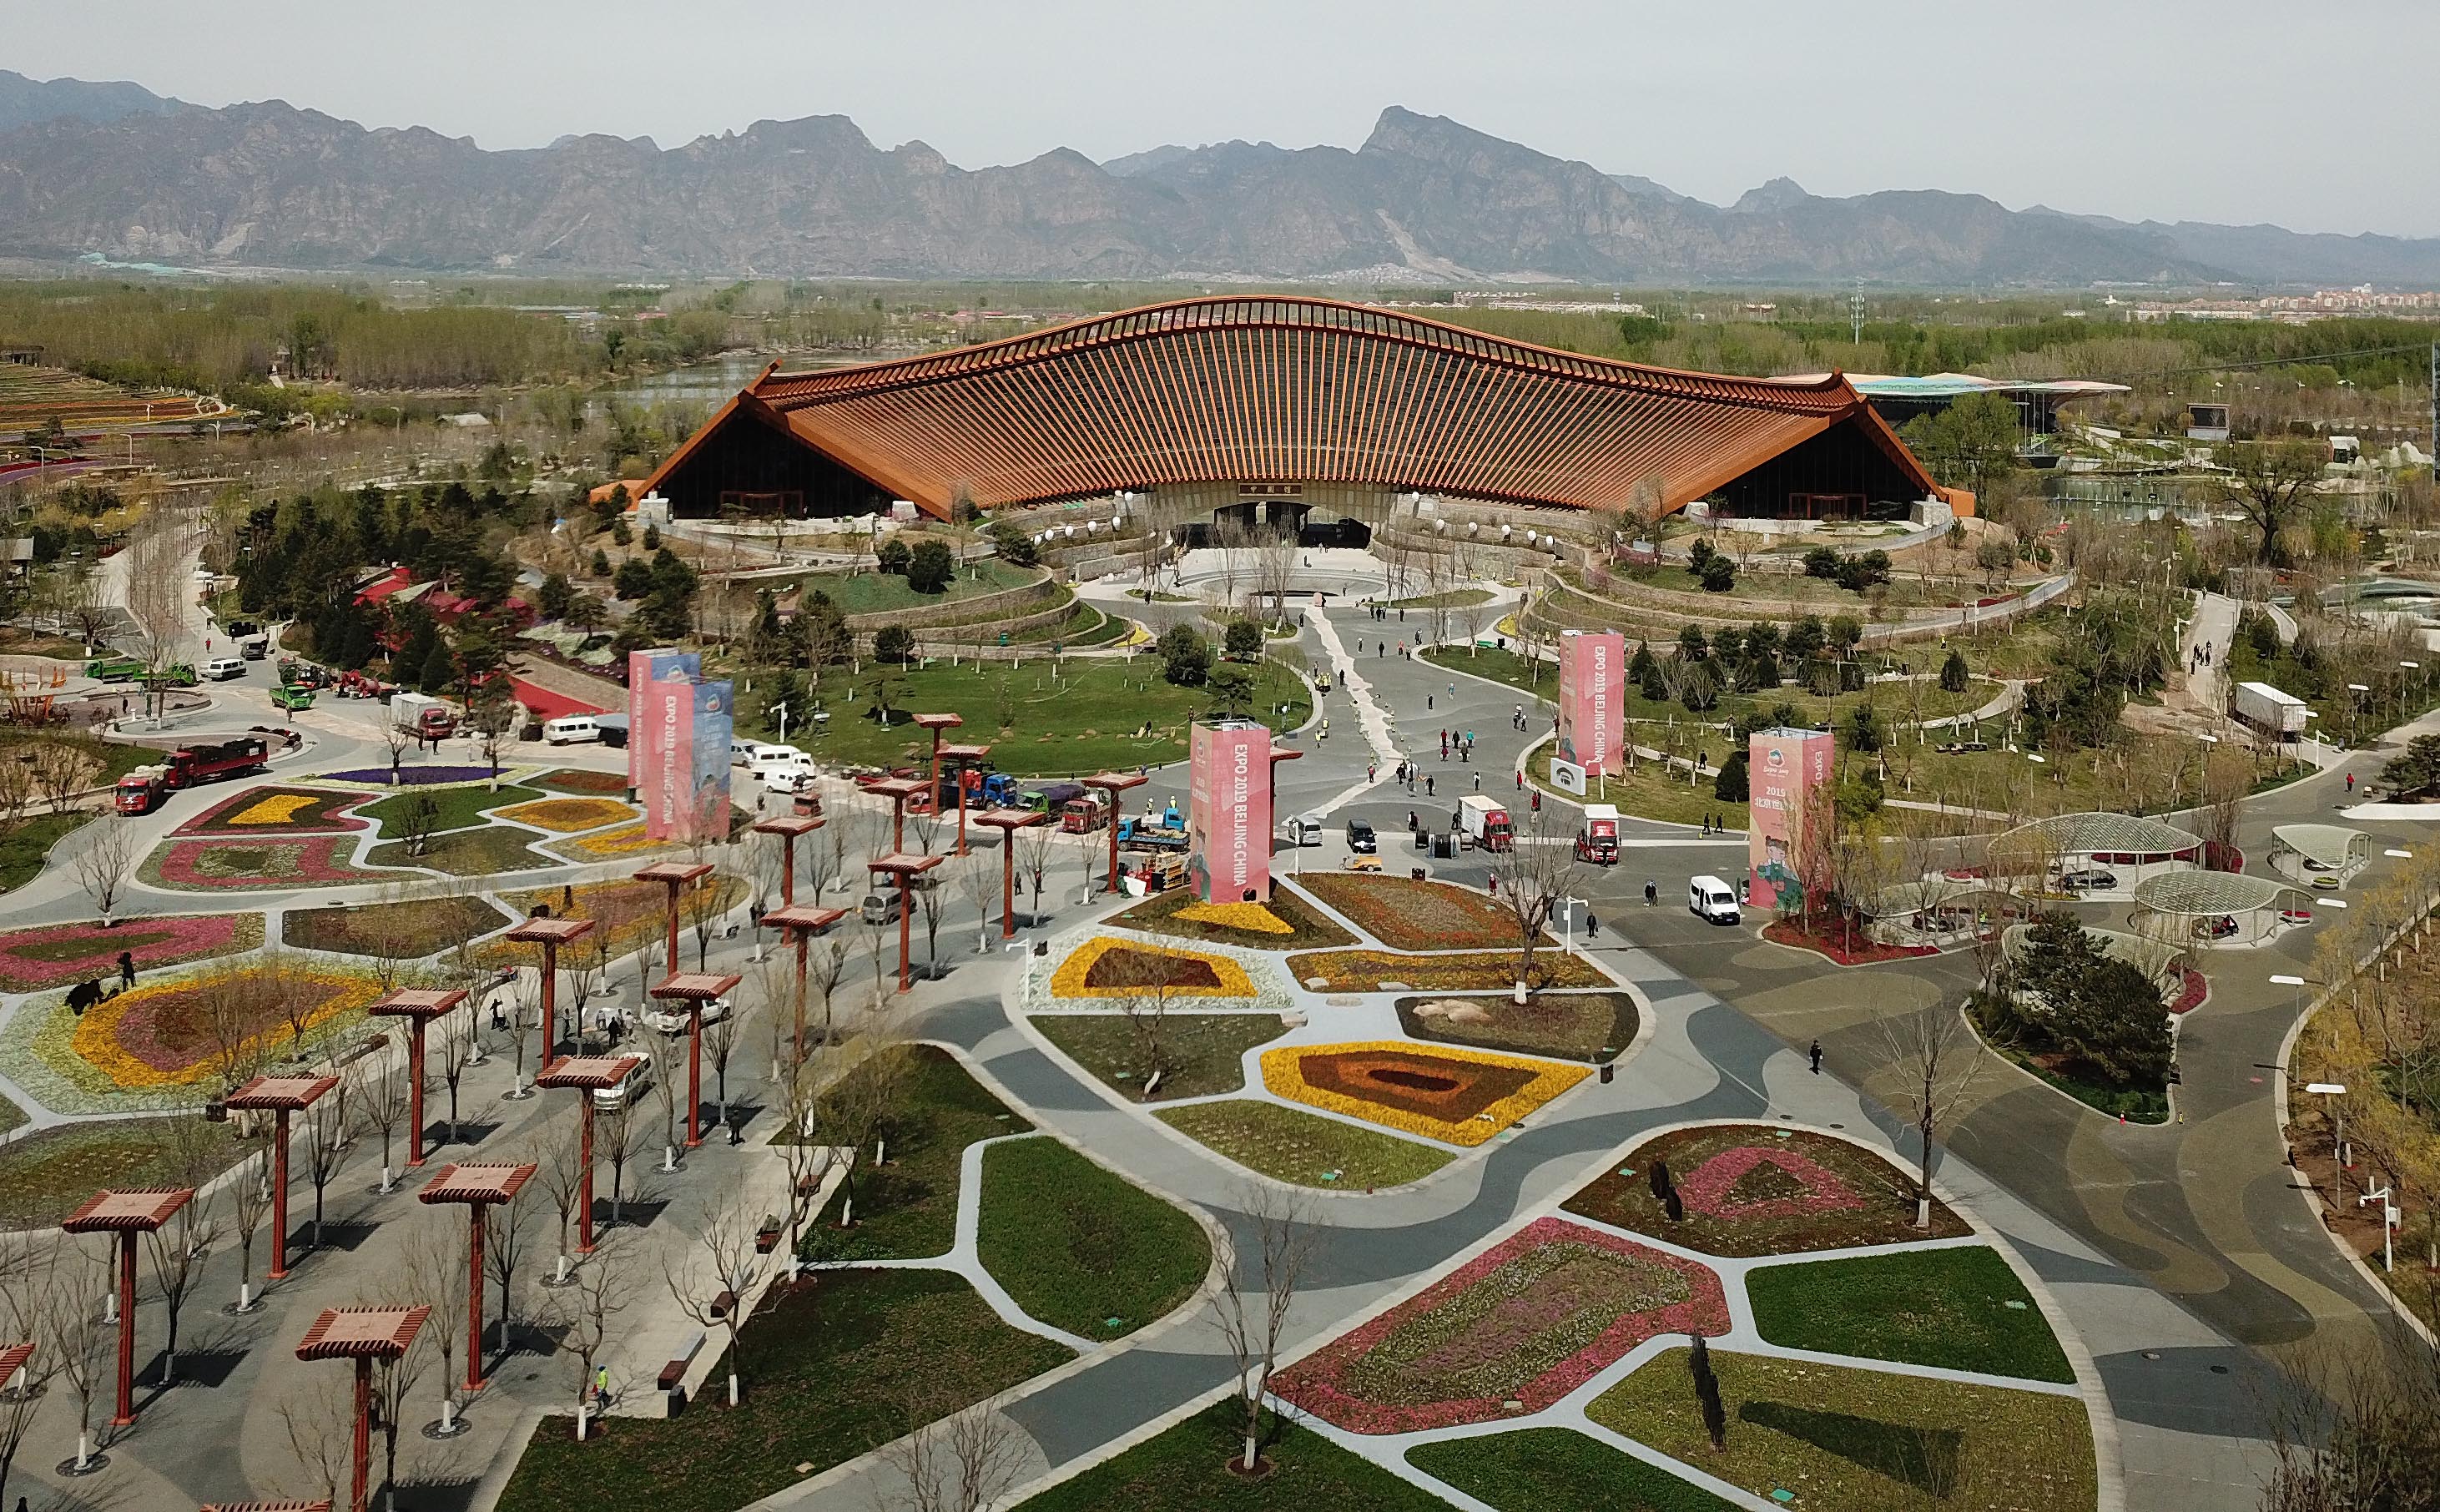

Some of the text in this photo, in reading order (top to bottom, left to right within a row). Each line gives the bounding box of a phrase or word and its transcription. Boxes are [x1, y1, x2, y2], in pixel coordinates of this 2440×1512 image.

[665, 695, 677, 723] EXPO
[1595, 646, 1606, 761] EXPO 2019 BEIJING CHINA
[664, 724, 676, 748] 2019
[663, 750, 675, 792] BEIJING
[1766, 786, 1786, 798] 2019
[1233, 743, 1248, 887] EXPO 2019 BEIJING CHINA
